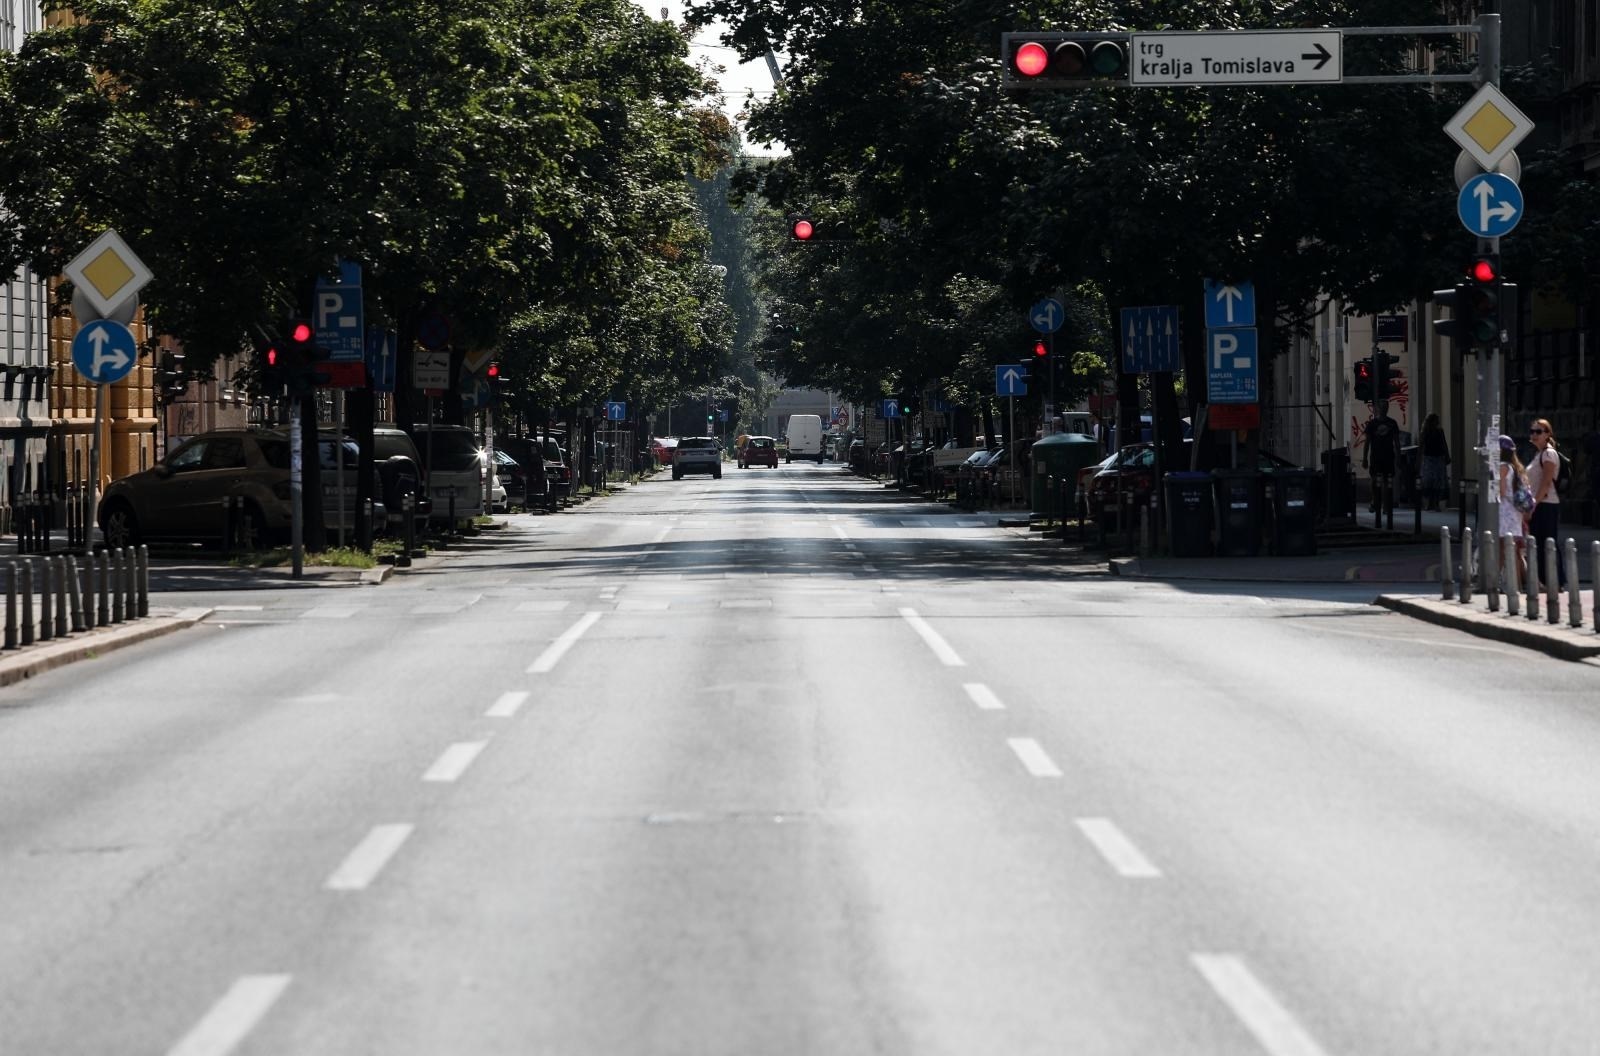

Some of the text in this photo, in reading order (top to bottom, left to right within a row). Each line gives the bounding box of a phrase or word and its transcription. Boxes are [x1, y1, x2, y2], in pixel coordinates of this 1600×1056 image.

[1140, 41, 1164, 58] trg
[1140, 57, 1295, 79] kralja Tomislava
[319, 293, 343, 328] P
[1213, 333, 1238, 369] P
